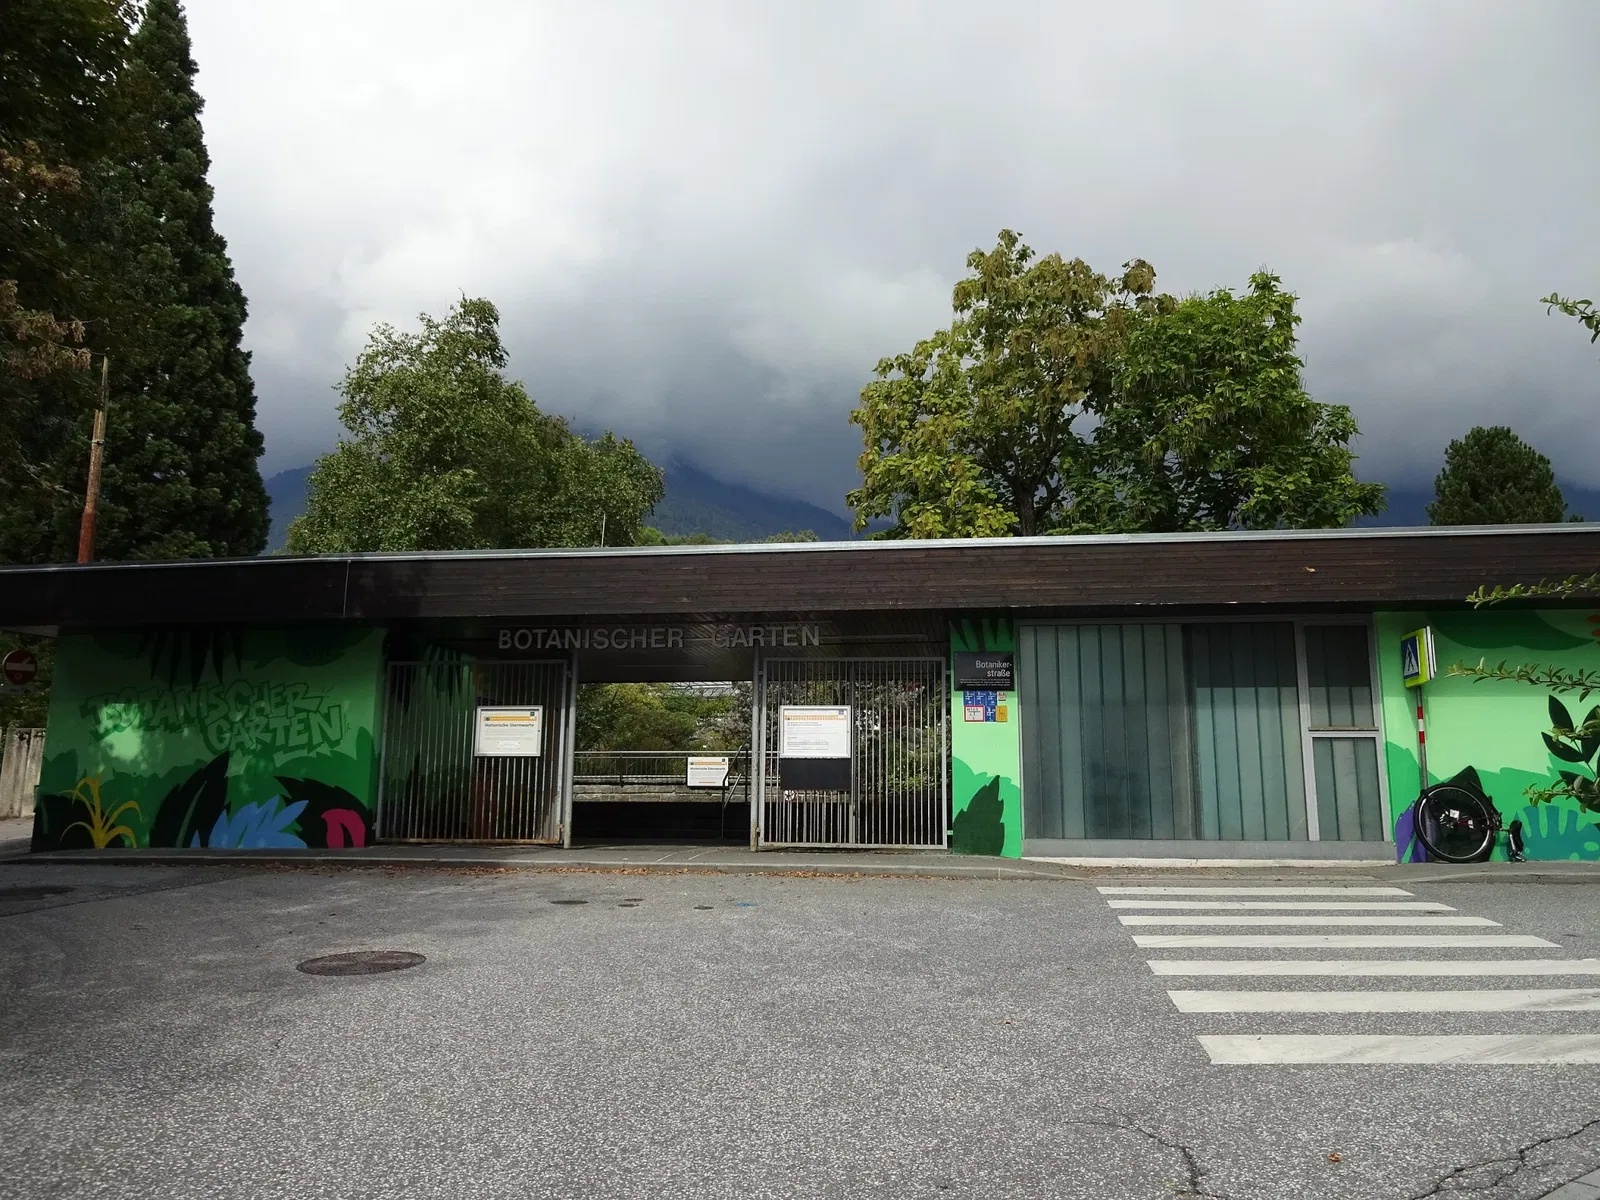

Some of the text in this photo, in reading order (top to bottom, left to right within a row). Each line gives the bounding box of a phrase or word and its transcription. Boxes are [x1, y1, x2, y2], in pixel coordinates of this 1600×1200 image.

[498, 626, 821, 649] BOTANISCHER GARTEN
[976, 660, 1012, 668] Botaniker-
[987, 669, 1010, 677] straße
[82, 679, 325, 731] BOTANISCHER
[204, 704, 344, 752] GARTEN
